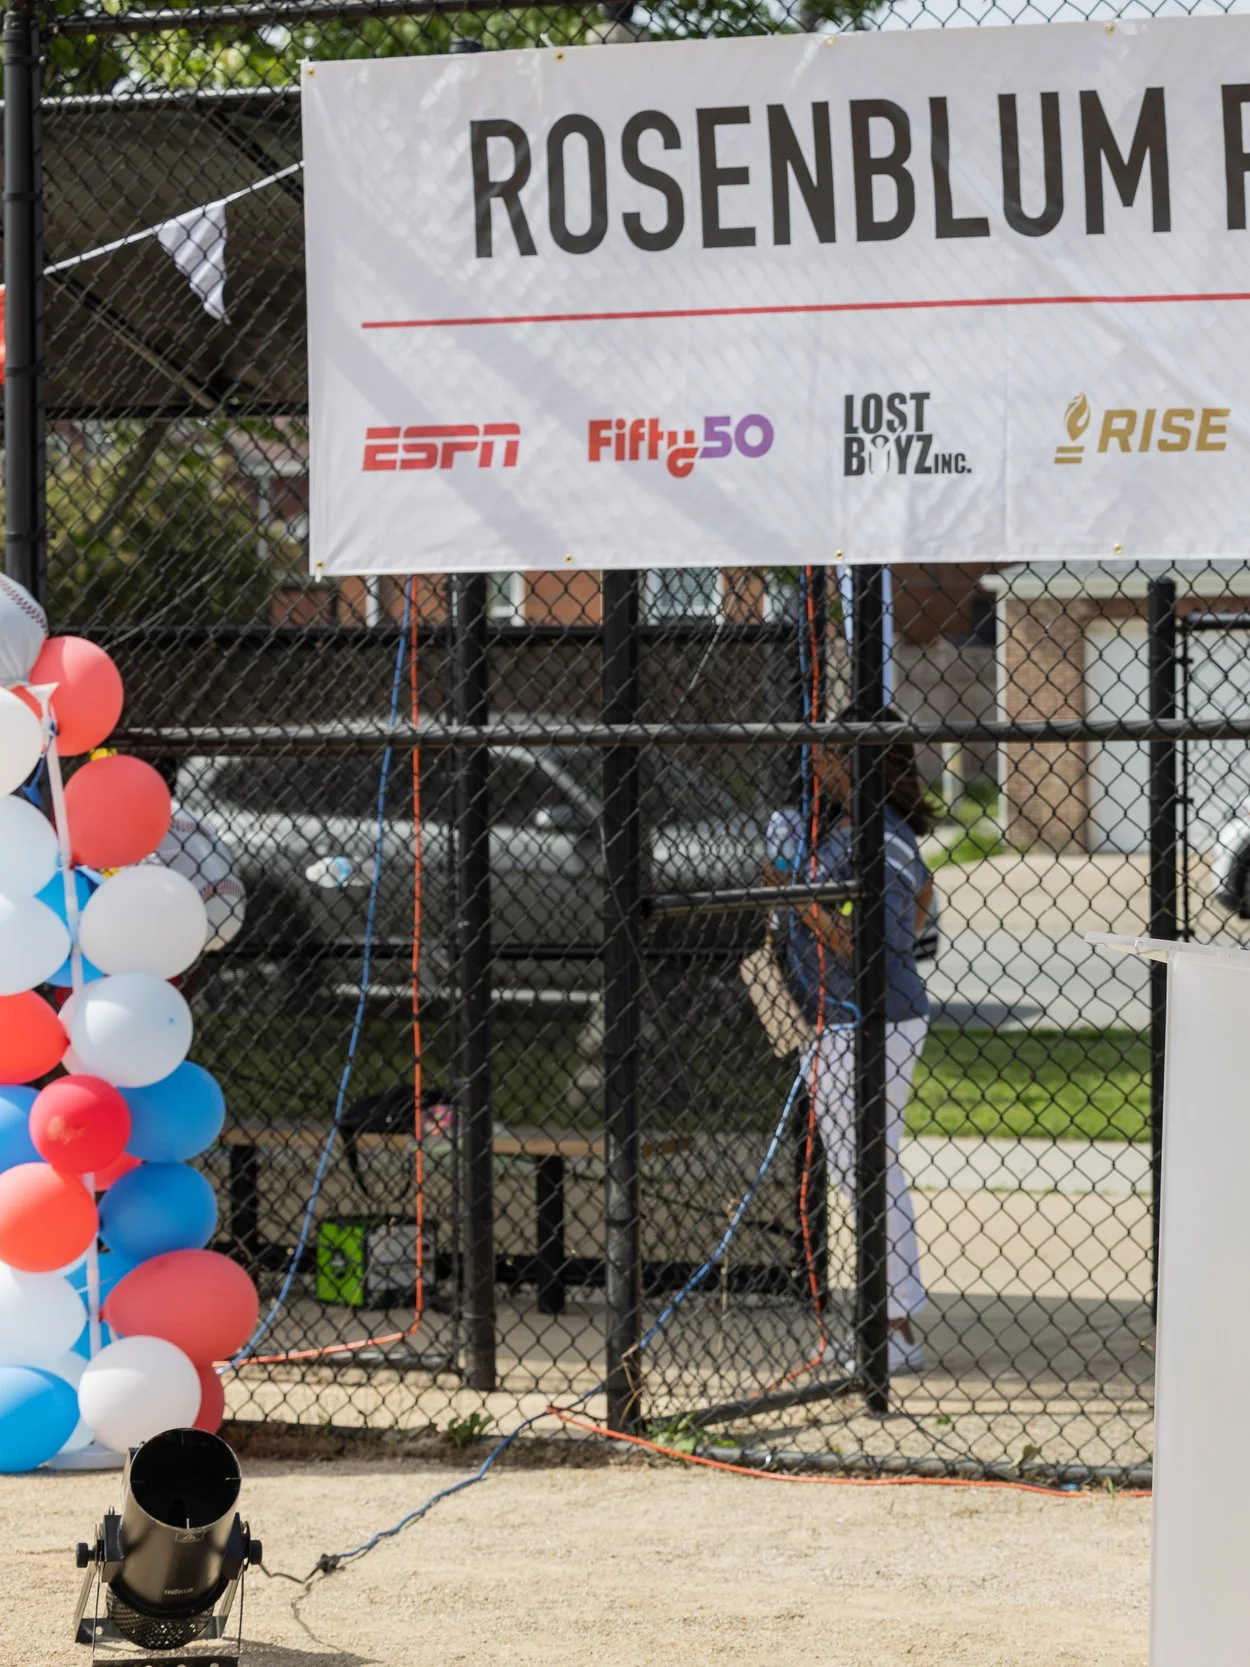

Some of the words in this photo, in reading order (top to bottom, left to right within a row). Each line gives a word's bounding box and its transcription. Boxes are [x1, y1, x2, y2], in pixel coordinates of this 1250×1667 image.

[469, 87, 1171, 259] ROSENBLUM
[844, 392, 930, 435] LOST
[1097, 408, 1231, 453] RISE
[362, 423, 521, 472] ESPN
[844, 433, 933, 476] BOYZ
[933, 453, 972, 474] INC.
